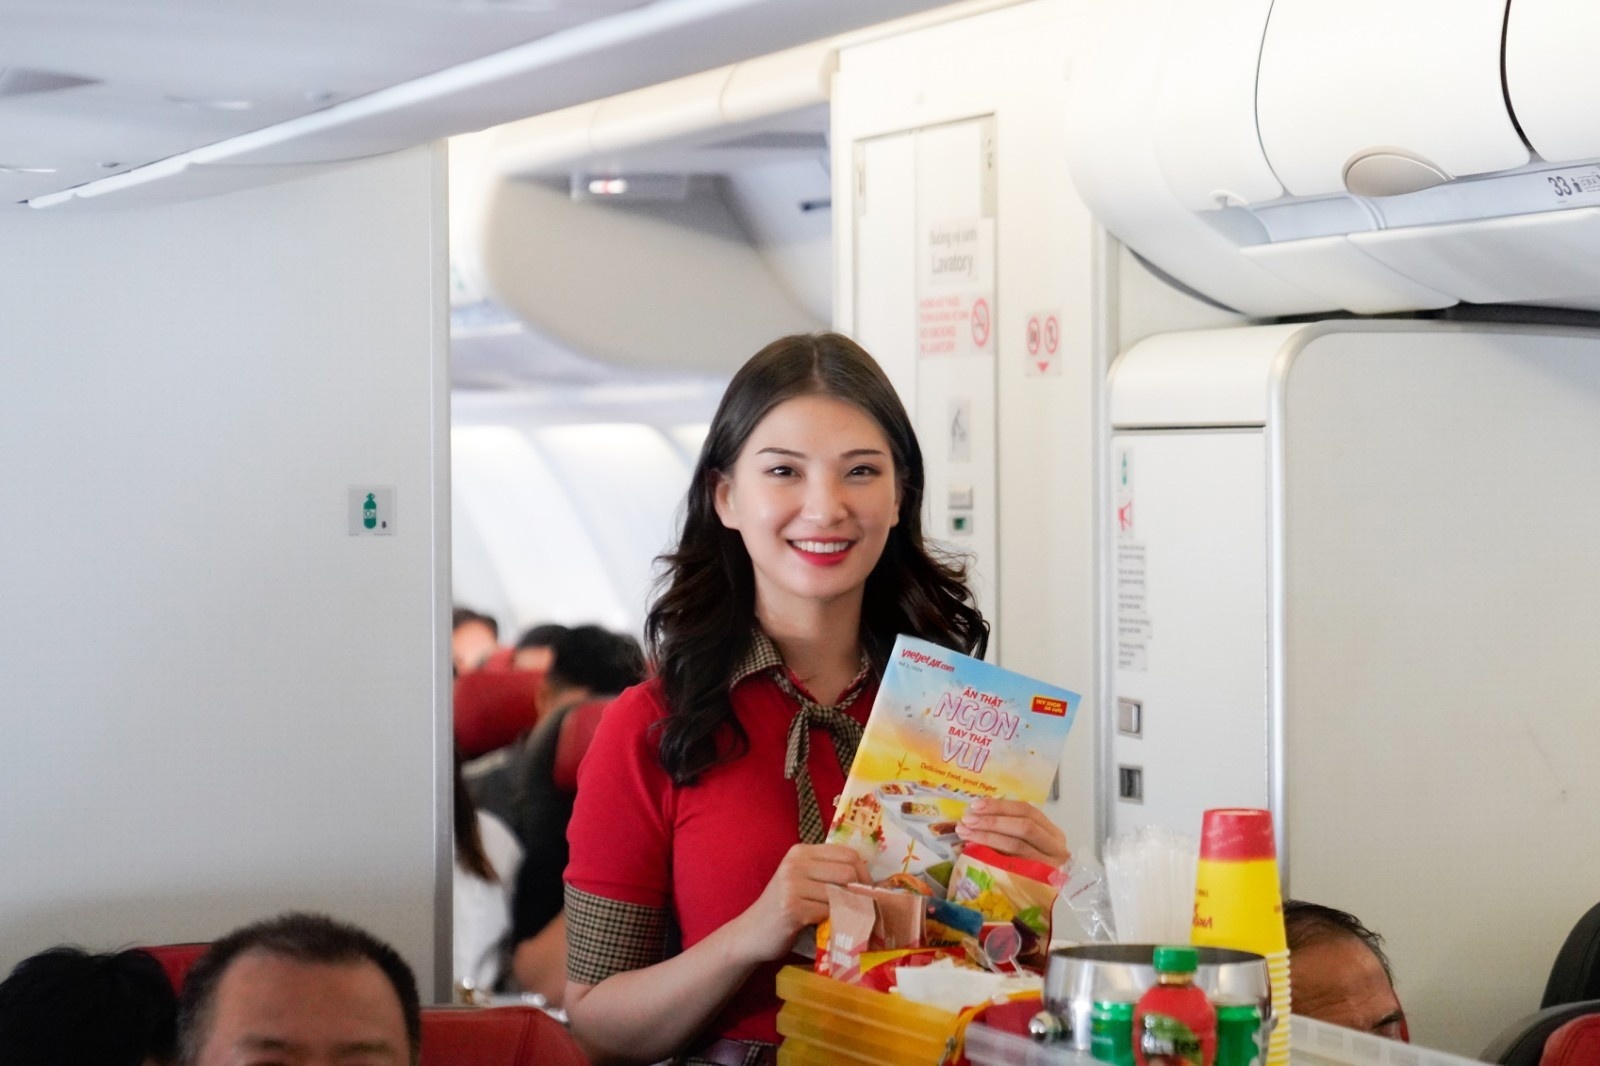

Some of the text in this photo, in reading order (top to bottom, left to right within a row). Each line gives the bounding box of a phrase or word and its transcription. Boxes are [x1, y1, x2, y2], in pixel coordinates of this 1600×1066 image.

[1547, 176, 1572, 196] 33
[932, 253, 974, 276] Lavatory
[980, 693, 1004, 708] THẬT
[933, 692, 1020, 741] NGON
[948, 726, 992, 748] BAY THẬT
[942, 737, 991, 774] VUI
[920, 762, 947, 778] Delicious
[963, 778, 979, 788] great
